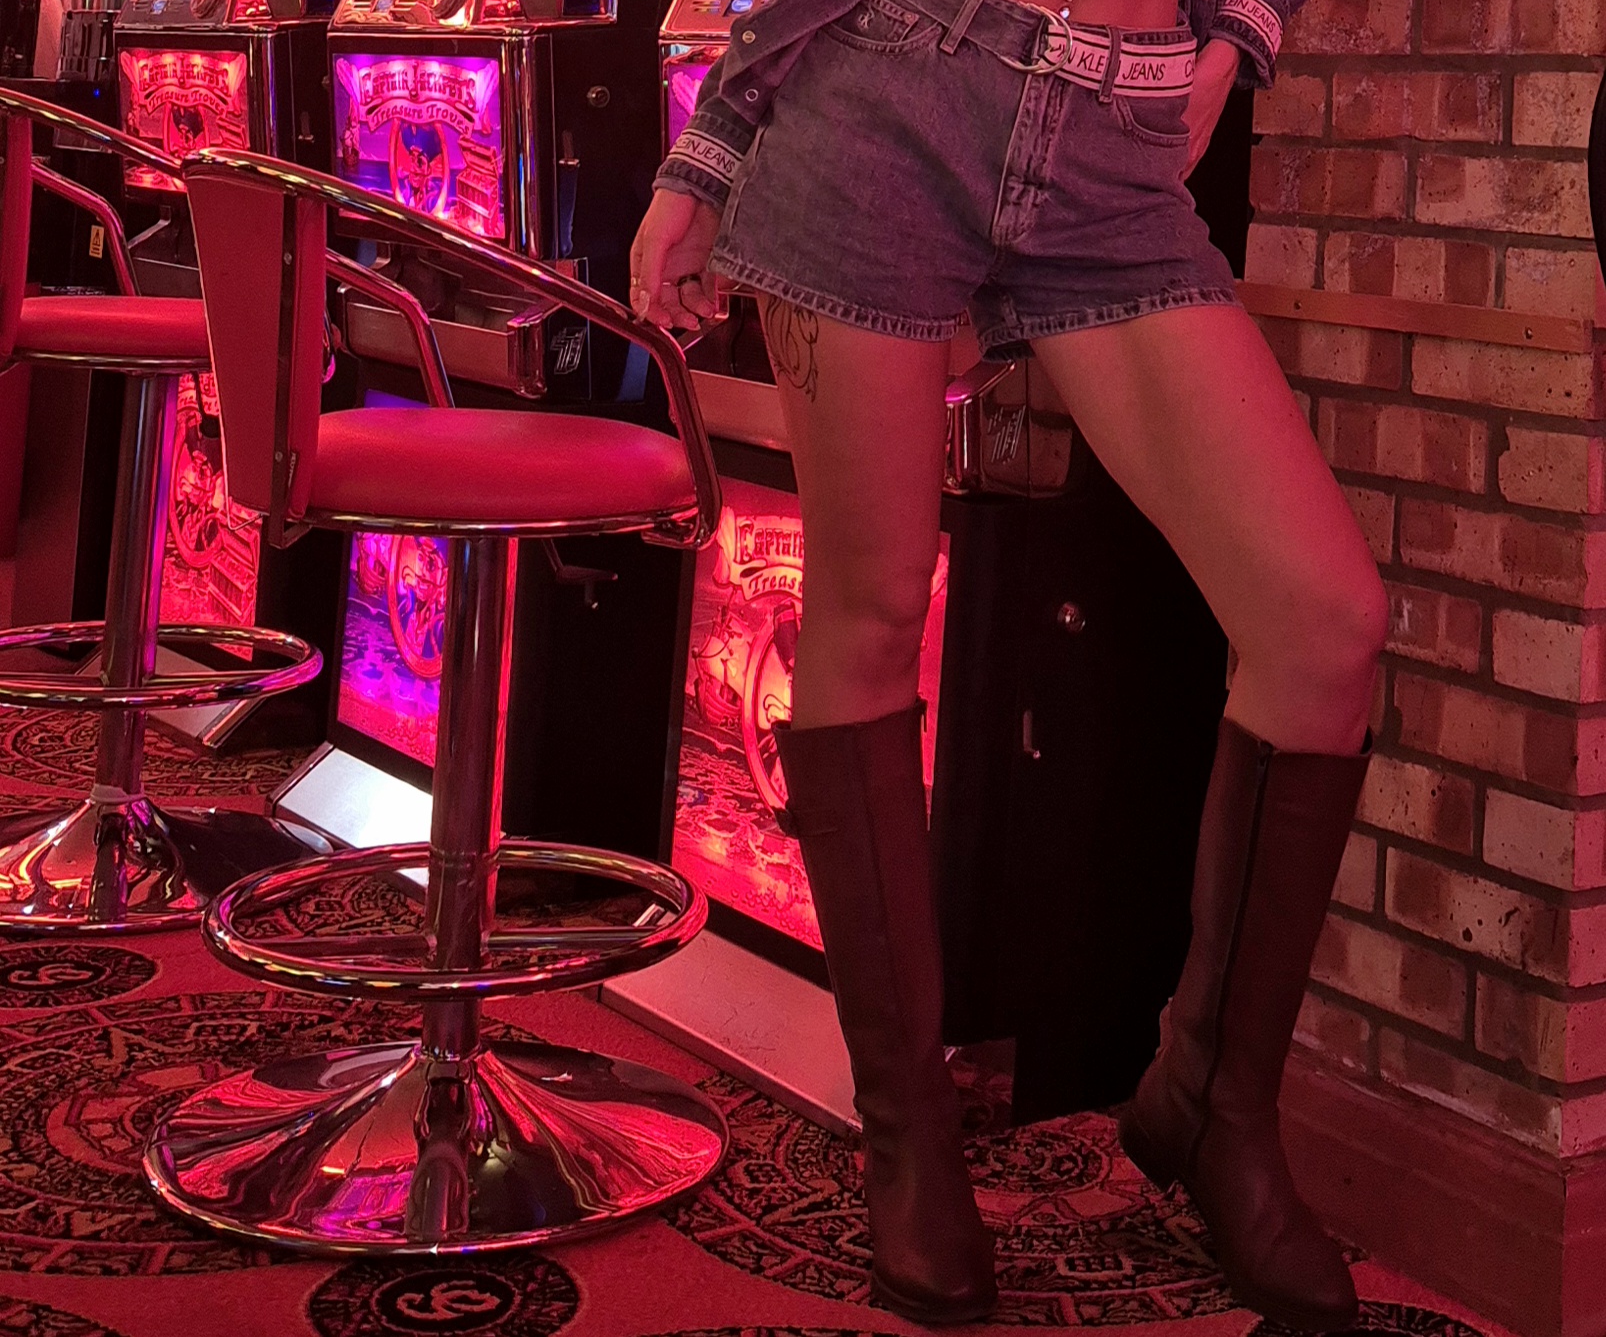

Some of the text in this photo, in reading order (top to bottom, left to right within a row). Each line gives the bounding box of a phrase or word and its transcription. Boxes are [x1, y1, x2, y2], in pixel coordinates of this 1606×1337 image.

[1247, 4, 1276, 33] JEANS
[1122, 62, 1166, 81] JEANS
[148, 90, 225, 115] Treasure Troves
[371, 104, 469, 135] Treasure Troves
[697, 145, 736, 174] JEANS
